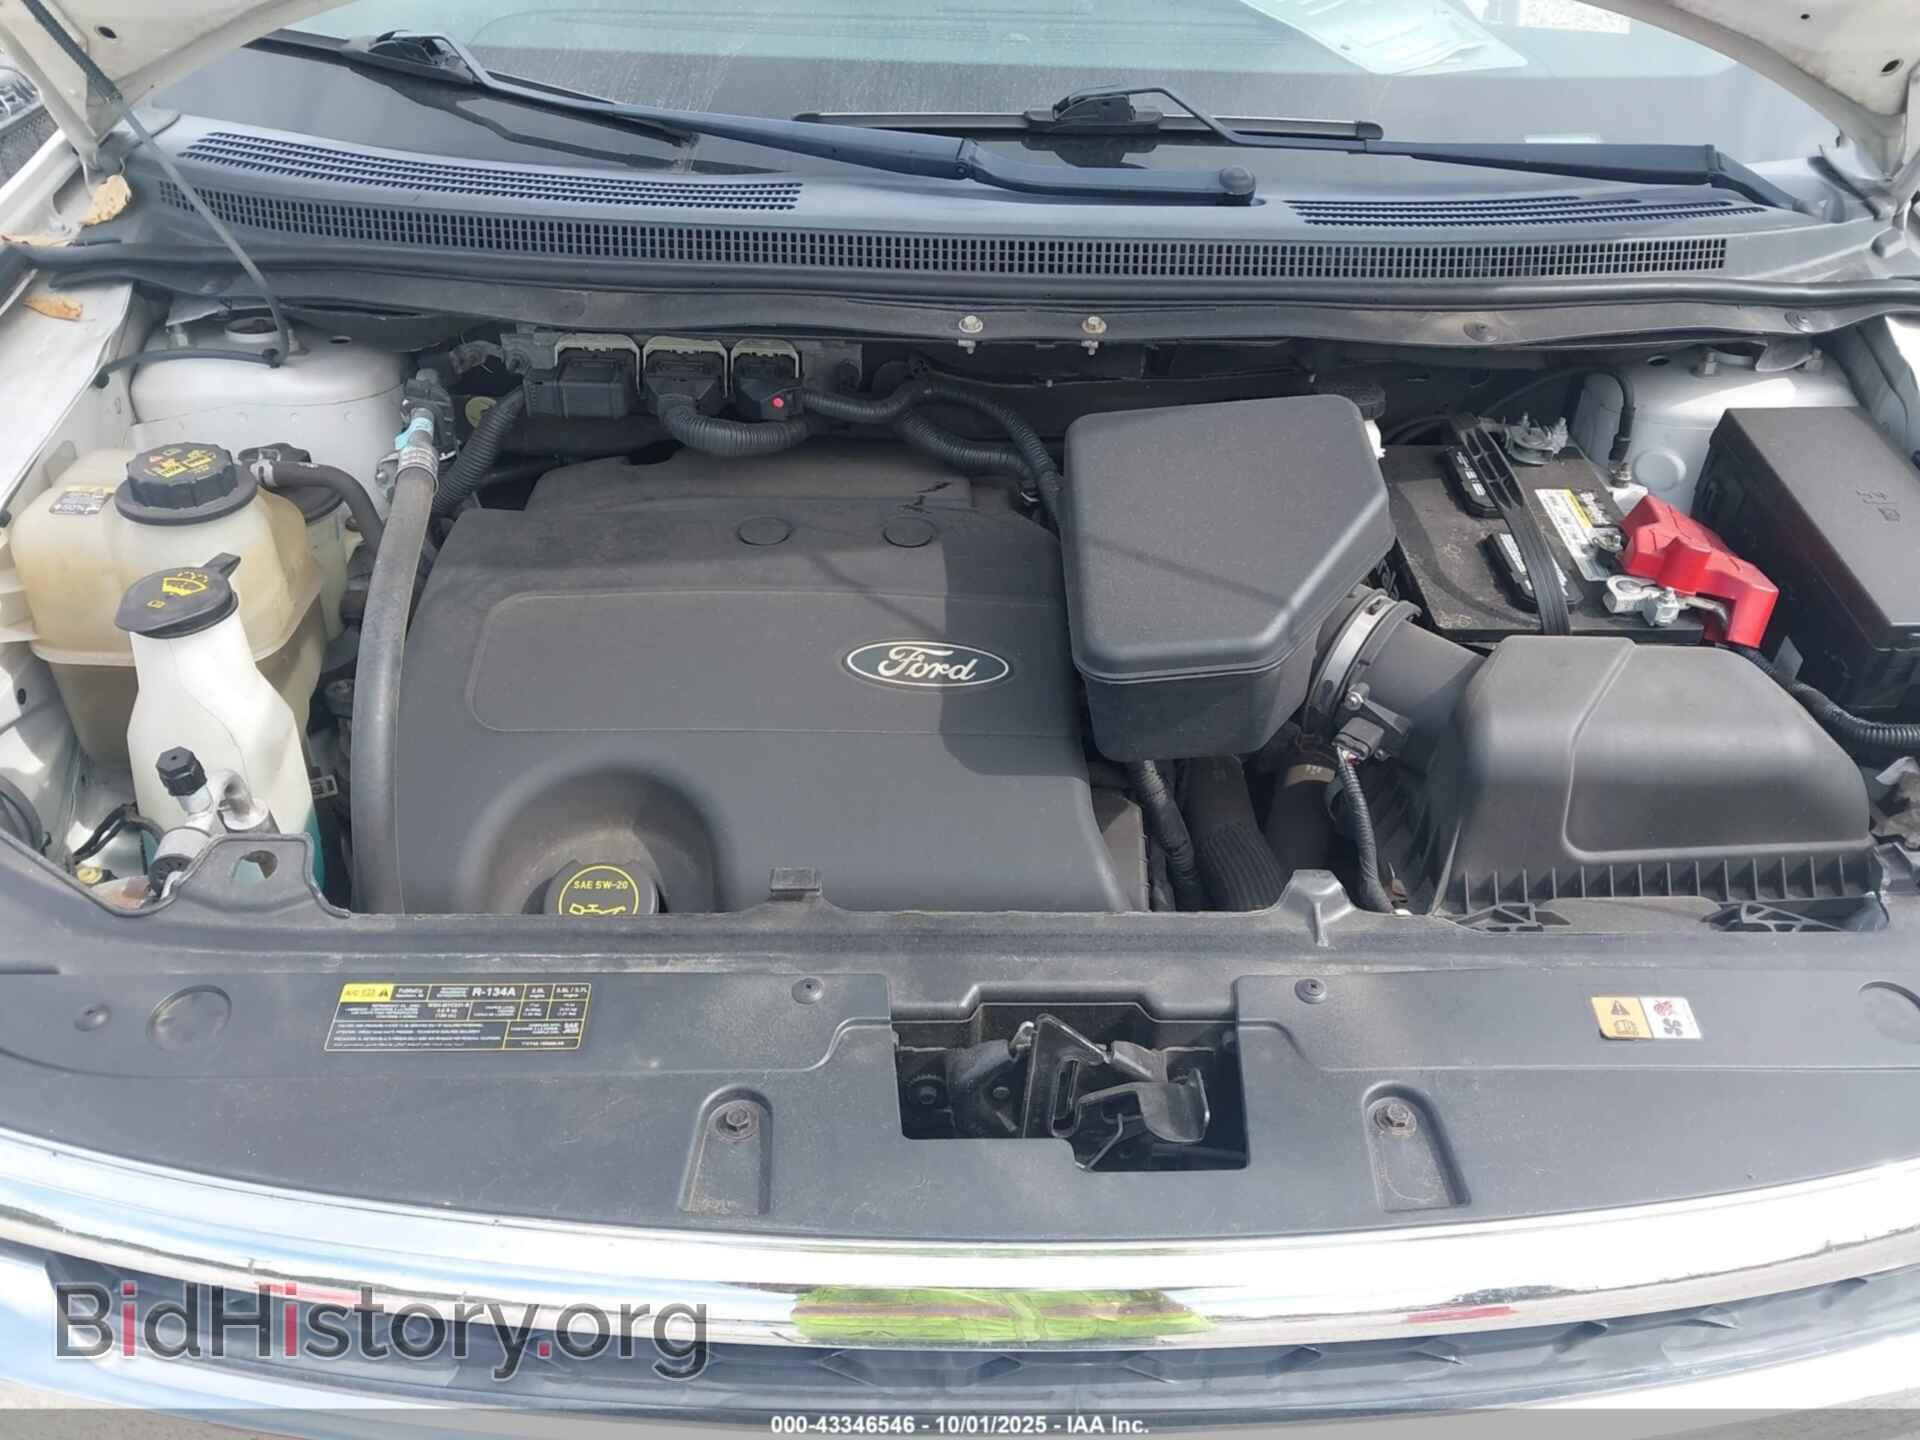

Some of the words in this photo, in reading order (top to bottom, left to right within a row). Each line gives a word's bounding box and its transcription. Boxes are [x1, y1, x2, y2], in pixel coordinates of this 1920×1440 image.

[877, 645, 979, 681] Ford
[573, 880, 593, 889] SAE
[595, 880, 628, 890] 5W-20
[471, 986, 516, 998] R-134A
